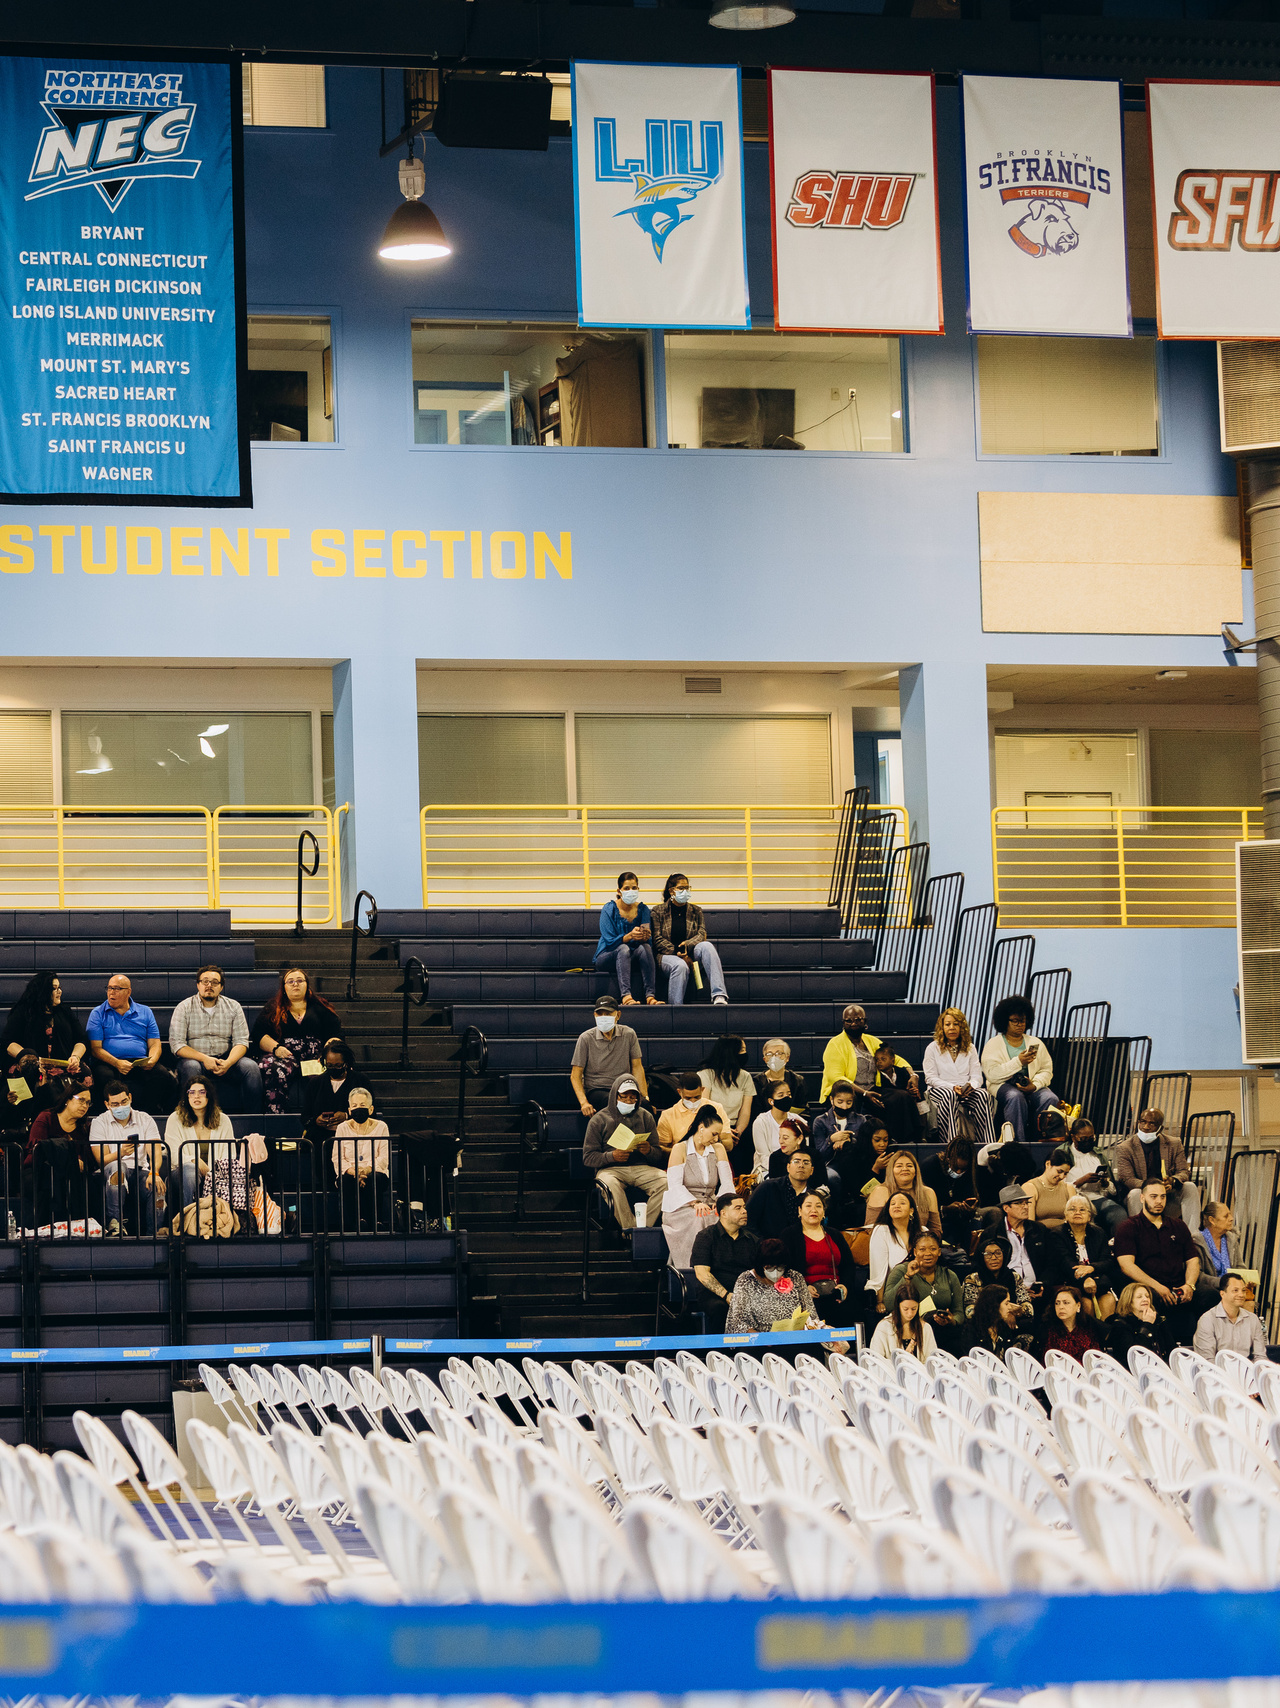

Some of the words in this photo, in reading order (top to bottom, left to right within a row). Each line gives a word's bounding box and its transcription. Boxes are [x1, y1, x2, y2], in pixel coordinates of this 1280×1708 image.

[46, 71, 181, 90] NORTHEAST
[46, 89, 181, 107] CONFERENCE
[35, 108, 191, 176] NEC
[594, 117, 724, 184] LIU
[996, 149, 1092, 163] BROOKLYN
[785, 170, 917, 230] SHU
[1018, 189, 1069, 198] TERRIERS
[81, 225, 144, 240] BRYANT
[19, 251, 92, 266] CENTRAL
[97, 252, 208, 269] CONNECTICUT
[26, 278, 111, 293] FAIRLEIGH
[115, 280, 202, 295] DICKINSON
[12, 305, 55, 319] LONG
[59, 305, 118, 320] ISLAND
[122, 307, 216, 323] UNIVERSITY
[67, 332, 164, 347] MERRIMACK
[40, 359, 98, 373] MOUNT
[101, 360, 126, 373] ST.
[131, 360, 190, 375] MARY'S
[55, 385, 119, 400] SACRED
[123, 386, 177, 401] HEART
[21, 413, 47, 426] ST.
[51, 413, 121, 427] FRANCIS
[126, 414, 210, 430] BROOKLYN
[48, 439, 96, 453] SAINT
[101, 439, 171, 454] FRANCIS
[175, 442, 186, 455] U
[82, 466, 153, 481] WAGNER
[311, 528, 574, 580] SECTION
